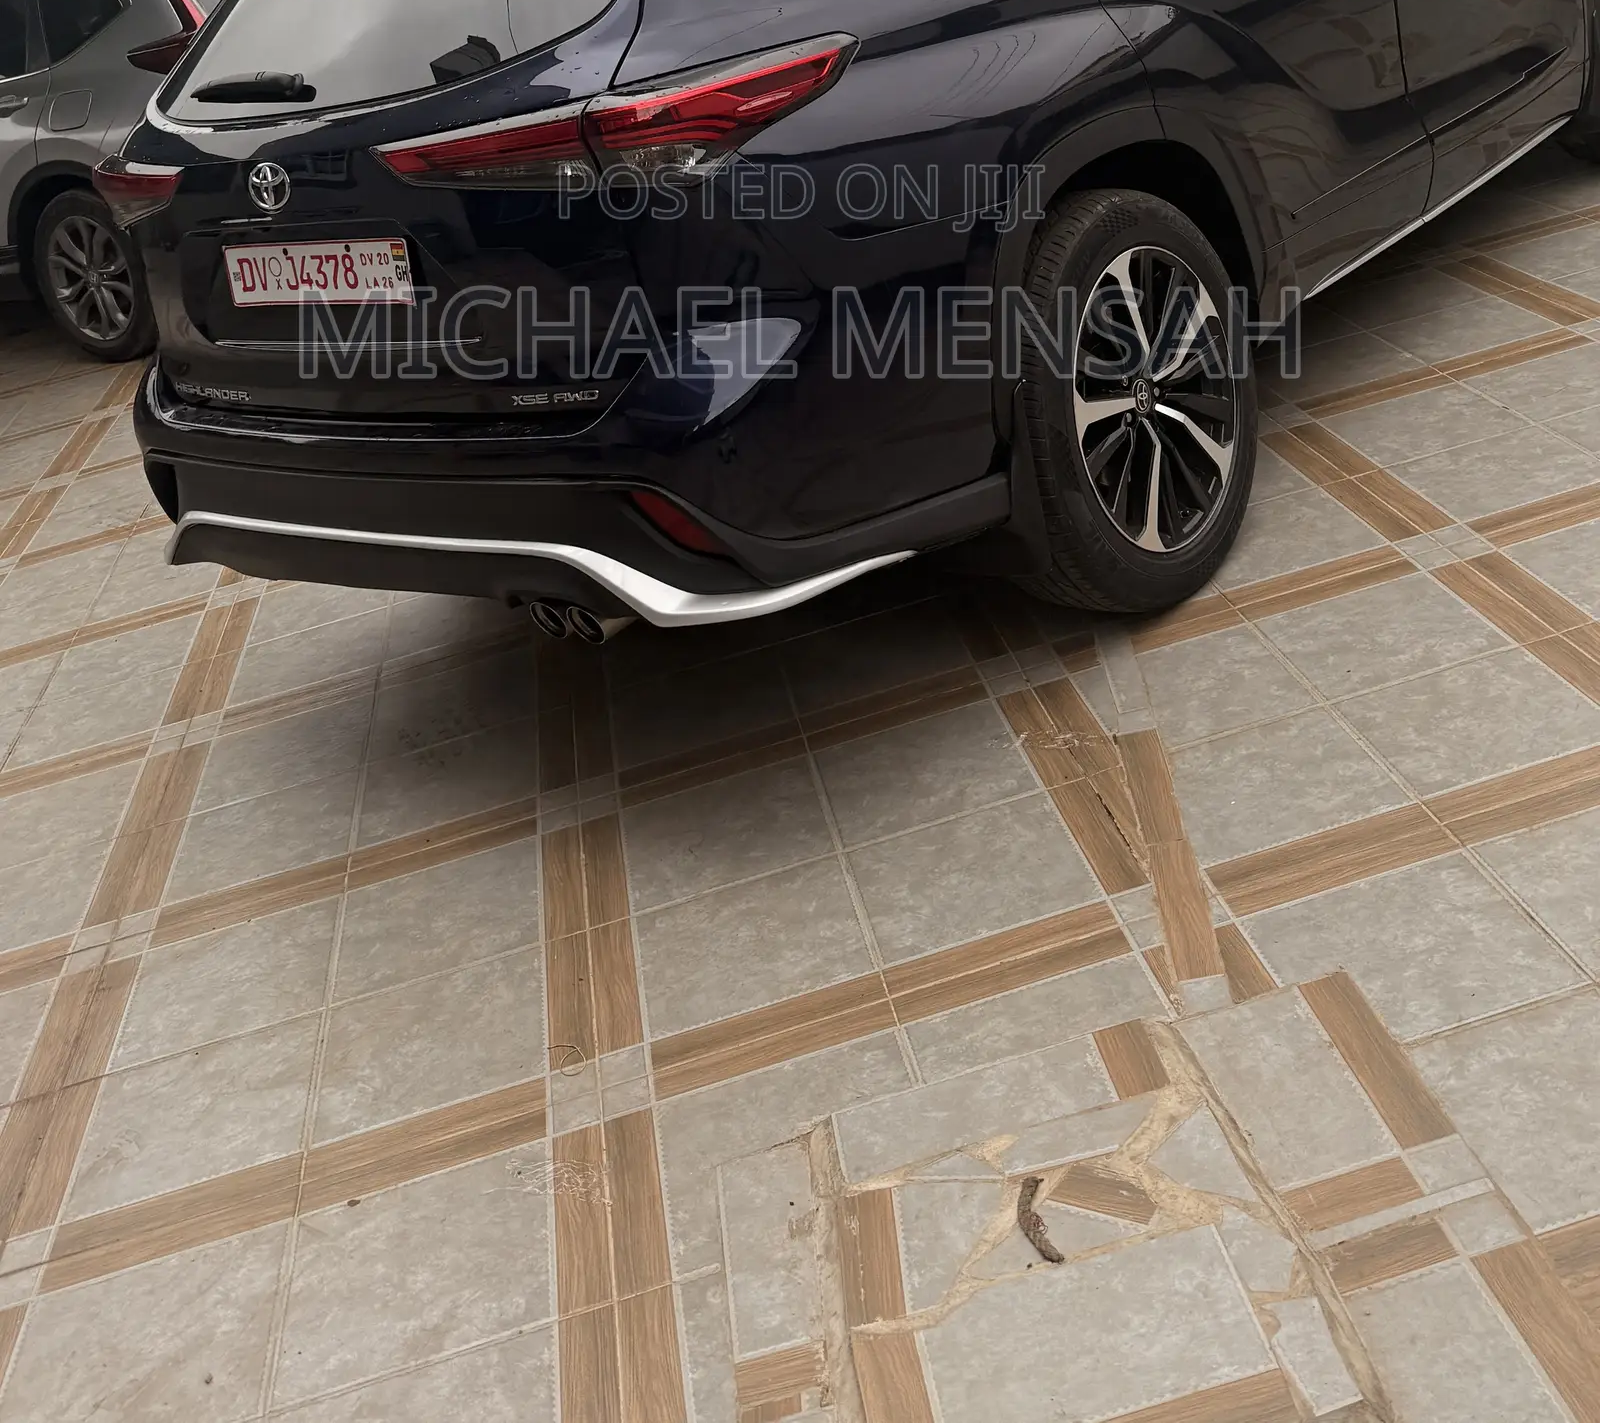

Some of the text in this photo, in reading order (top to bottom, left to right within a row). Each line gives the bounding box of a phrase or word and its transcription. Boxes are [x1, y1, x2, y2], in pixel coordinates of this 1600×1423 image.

[360, 252, 390, 266] DV 20
[237, 258, 268, 293] DV
[394, 264, 409, 282] GH
[365, 276, 394, 290] LA 26
[511, 389, 600, 407] XSE AWD
